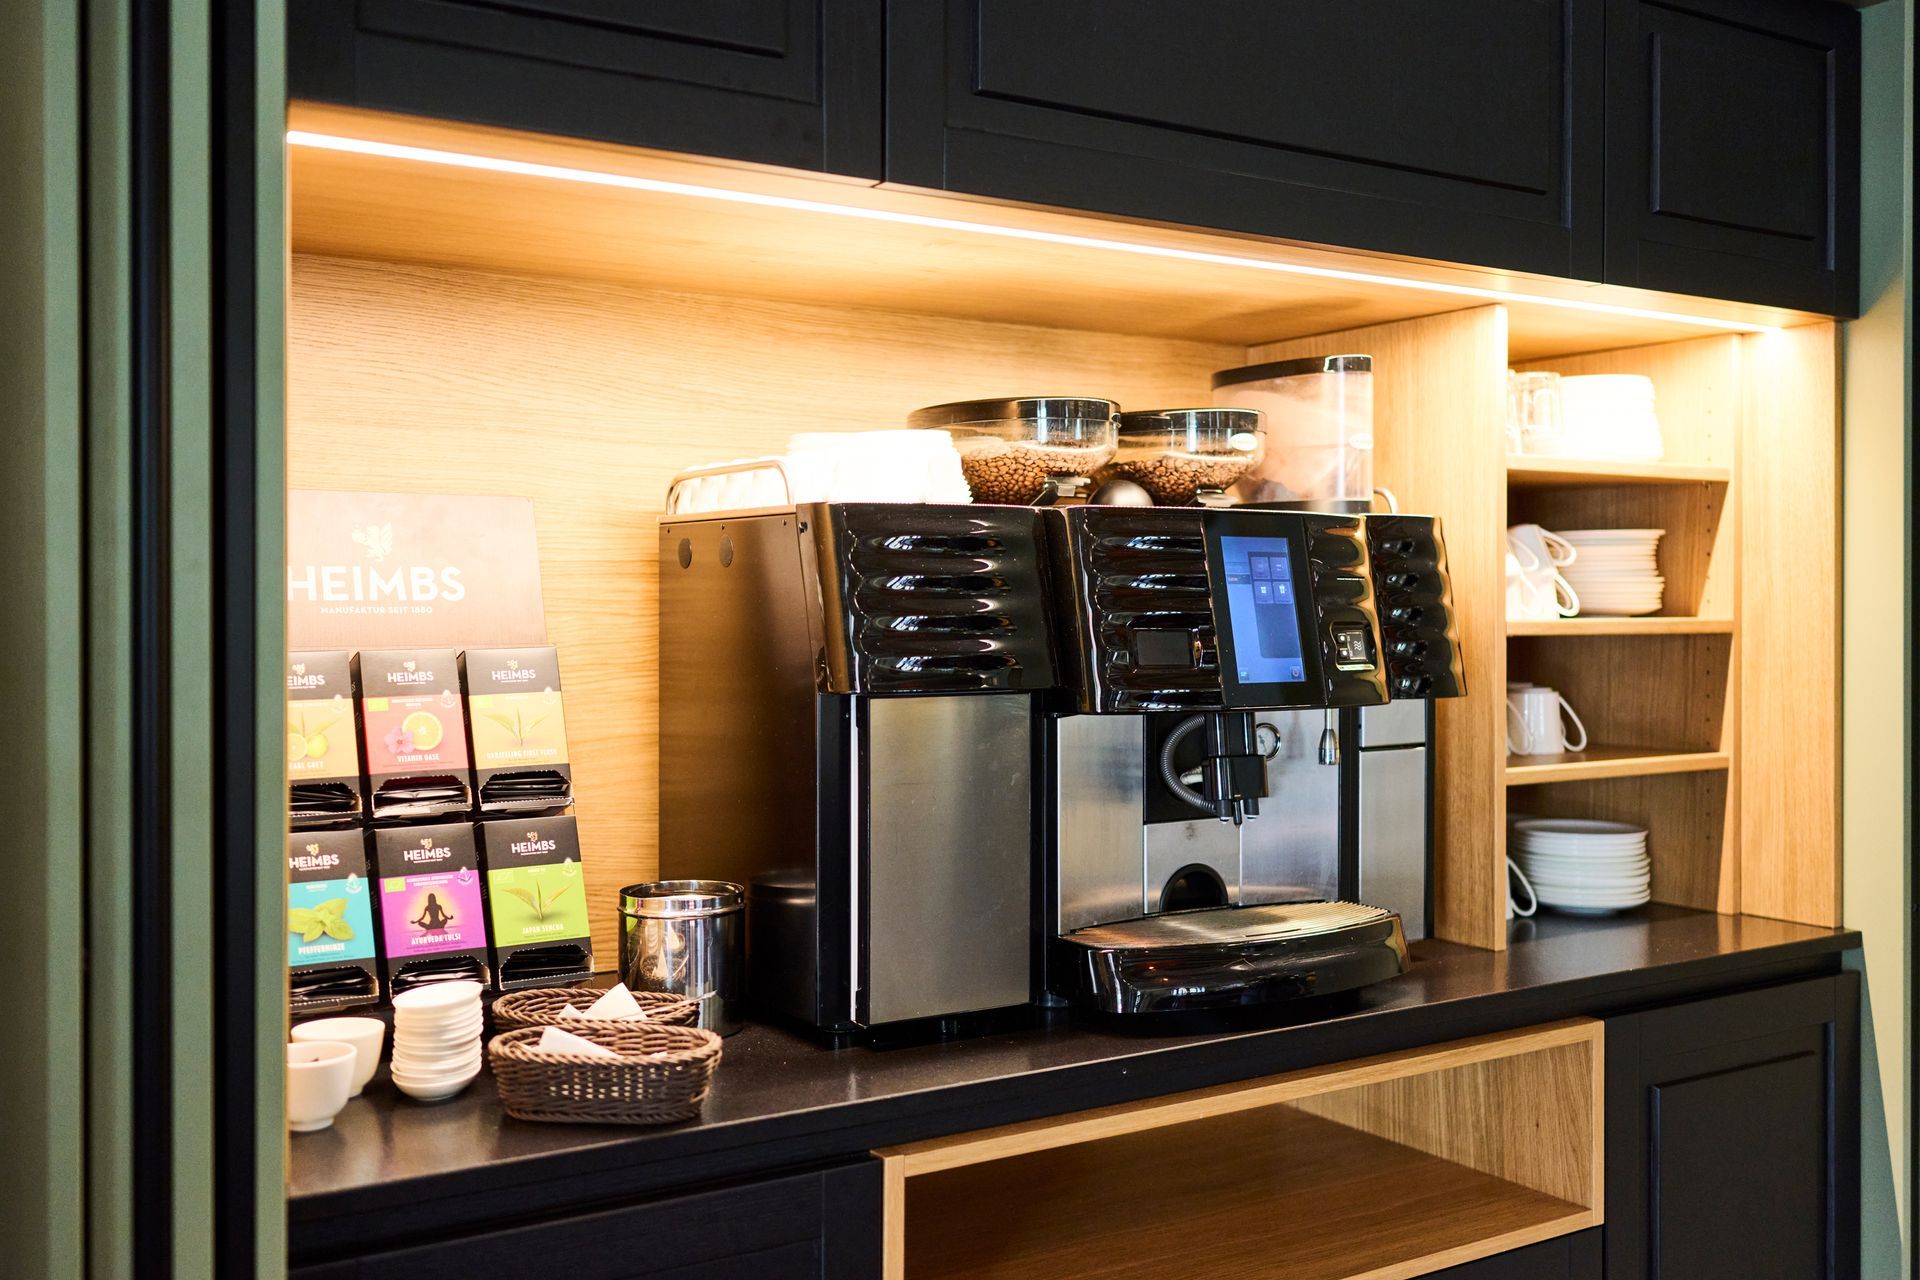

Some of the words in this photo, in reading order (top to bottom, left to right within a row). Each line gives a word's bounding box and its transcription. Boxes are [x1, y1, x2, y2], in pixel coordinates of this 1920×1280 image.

[287, 564, 464, 602] HEIMBS
[320, 606, 385, 616] MANUFAKTUR
[388, 606, 408, 615] SEIT
[411, 605, 432, 615] 1880
[387, 671, 434, 683] HEIMBS
[491, 669, 536, 681] HEIMBS
[511, 839, 556, 854] HEIMBS
[403, 847, 452, 861] HEIMBS
[288, 853, 340, 869] HEIMBS
[411, 934, 443, 946] AYURVEDA
[444, 933, 461, 943] TULSI
